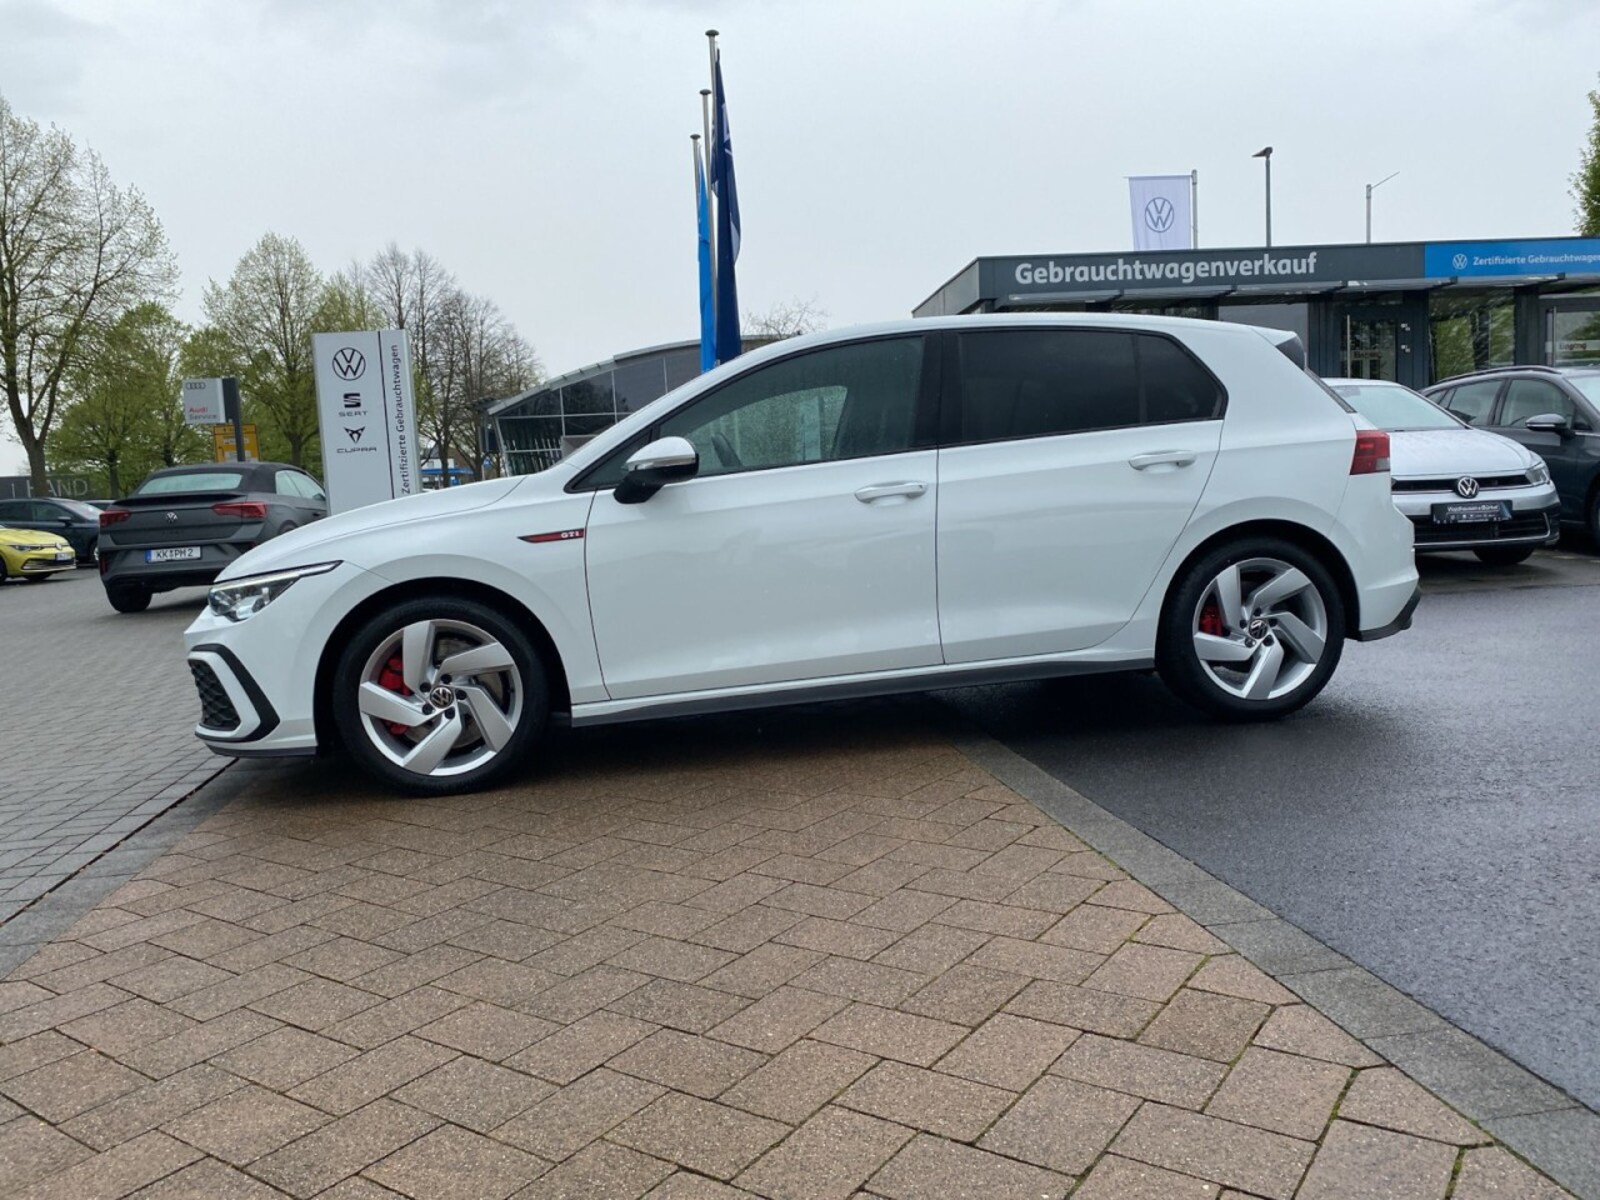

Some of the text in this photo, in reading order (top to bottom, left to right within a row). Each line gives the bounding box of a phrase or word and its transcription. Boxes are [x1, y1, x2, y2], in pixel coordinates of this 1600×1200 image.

[1473, 255, 1526, 266] Zertifizierte
[1015, 252, 1317, 284] Gebrauchtwagenverkauf
[390, 344, 410, 494] Zertifizierte Gebrauchtwagen
[561, 531, 580, 539] GTI
[156, 550, 169, 559] KK
[188, 548, 194, 557] 2
